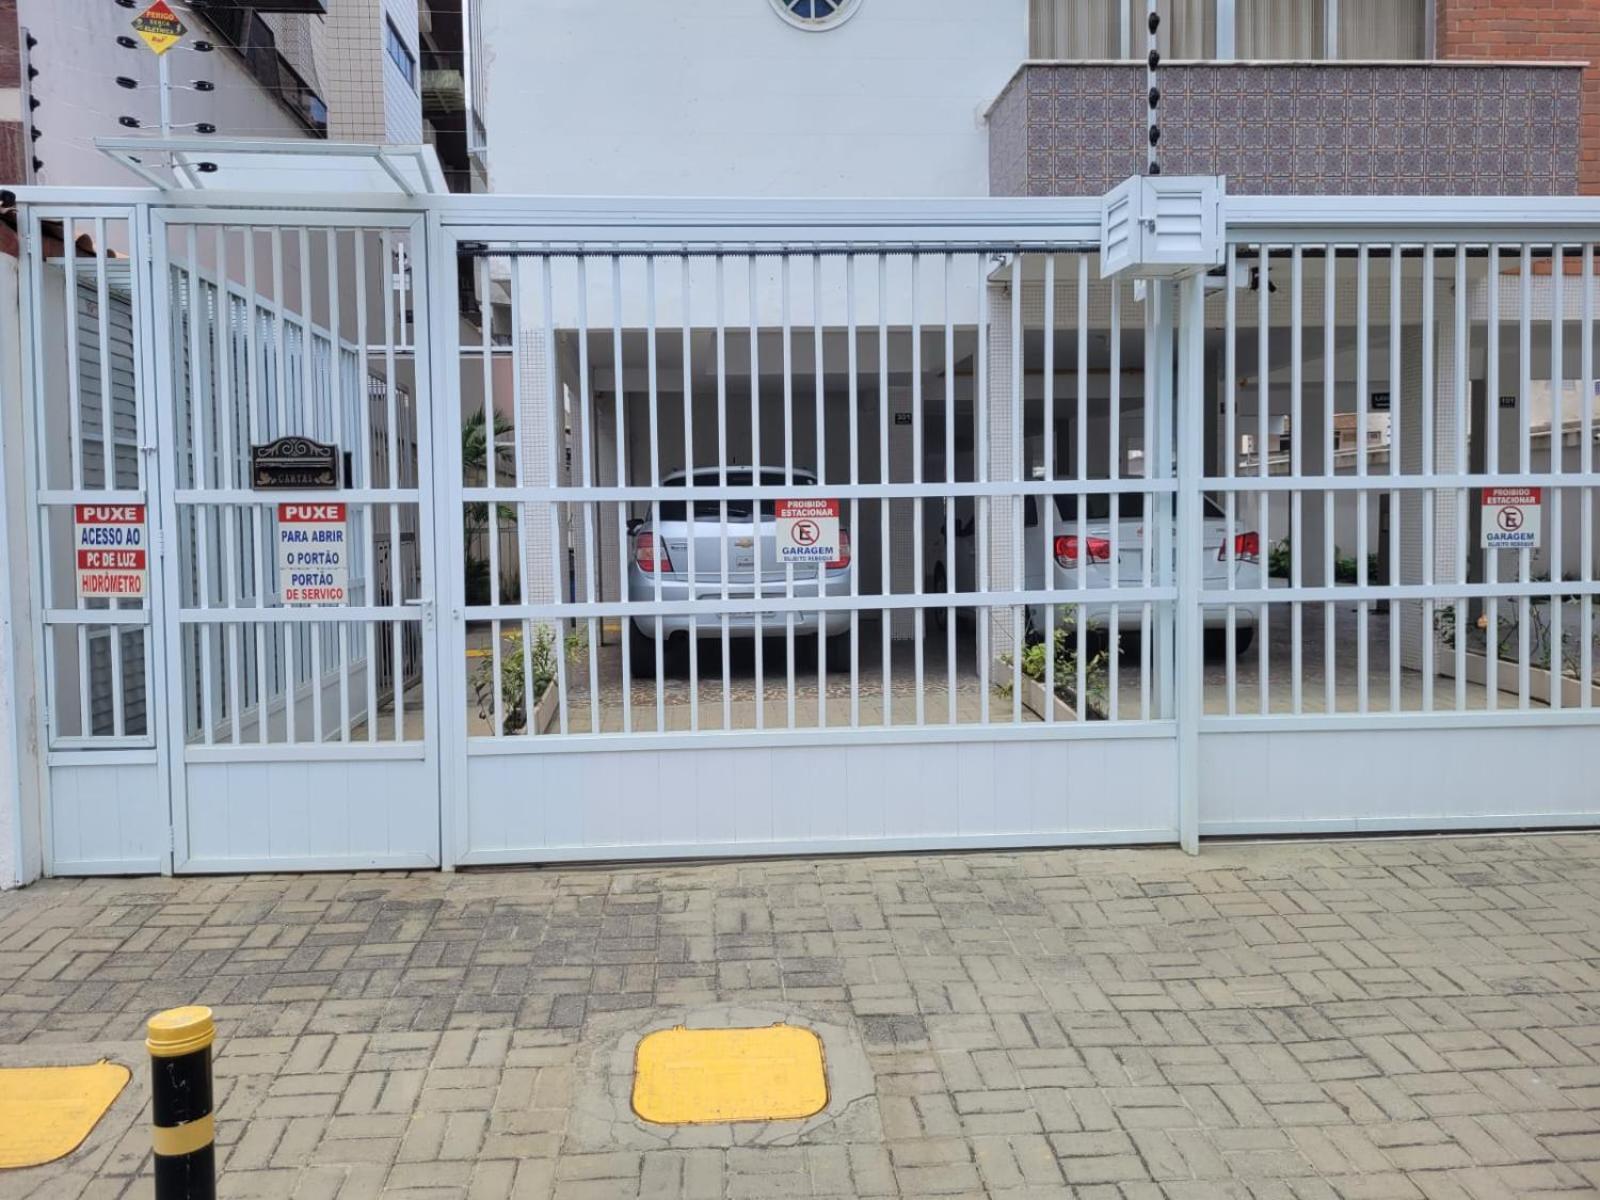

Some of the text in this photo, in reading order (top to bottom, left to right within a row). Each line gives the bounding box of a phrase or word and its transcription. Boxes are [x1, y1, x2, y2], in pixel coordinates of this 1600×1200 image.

[146, 11, 174, 20] PERIGO
[1493, 488, 1530, 496] PROIBIDO
[1487, 496, 1536, 504] ESTACIONAR
[83, 507, 137, 521] PUXE
[285, 506, 339, 519] PUXE
[781, 508, 833, 517] ESTACIONAR
[81, 527, 140, 545] ACESSO AO
[281, 530, 344, 542] PARA ABRIR
[1486, 533, 1535, 541] GARAGEM
[287, 549, 340, 565] O PORTÃO
[782, 547, 834, 555] GARAGEM
[86, 551, 137, 567] PC DE LUZ
[291, 571, 334, 586] PORTÃO
[286, 588, 299, 600] DE
